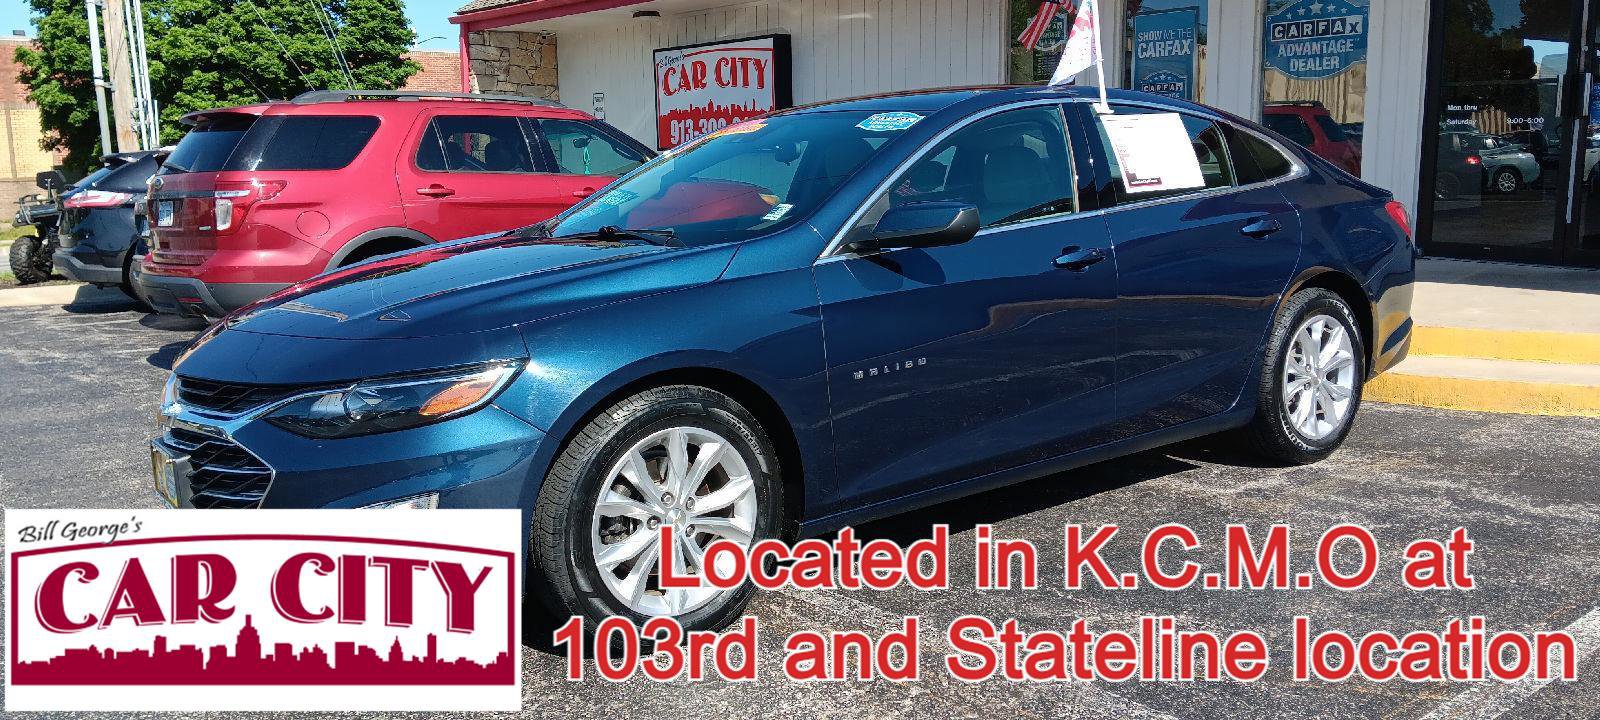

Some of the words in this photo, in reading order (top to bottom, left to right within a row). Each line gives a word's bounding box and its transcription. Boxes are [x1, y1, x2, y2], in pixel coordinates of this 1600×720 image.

[1138, 30, 1162, 41] SHOW
[1163, 30, 1175, 40] ME
[1177, 28, 1191, 38] THE
[1271, 15, 1363, 41] CARFAX
[1138, 39, 1193, 59] CARFAX
[1290, 56, 1340, 71] DEALER
[662, 61, 707, 97] CAR
[714, 57, 768, 90] CITY
[1446, 118, 1477, 127] Saturday
